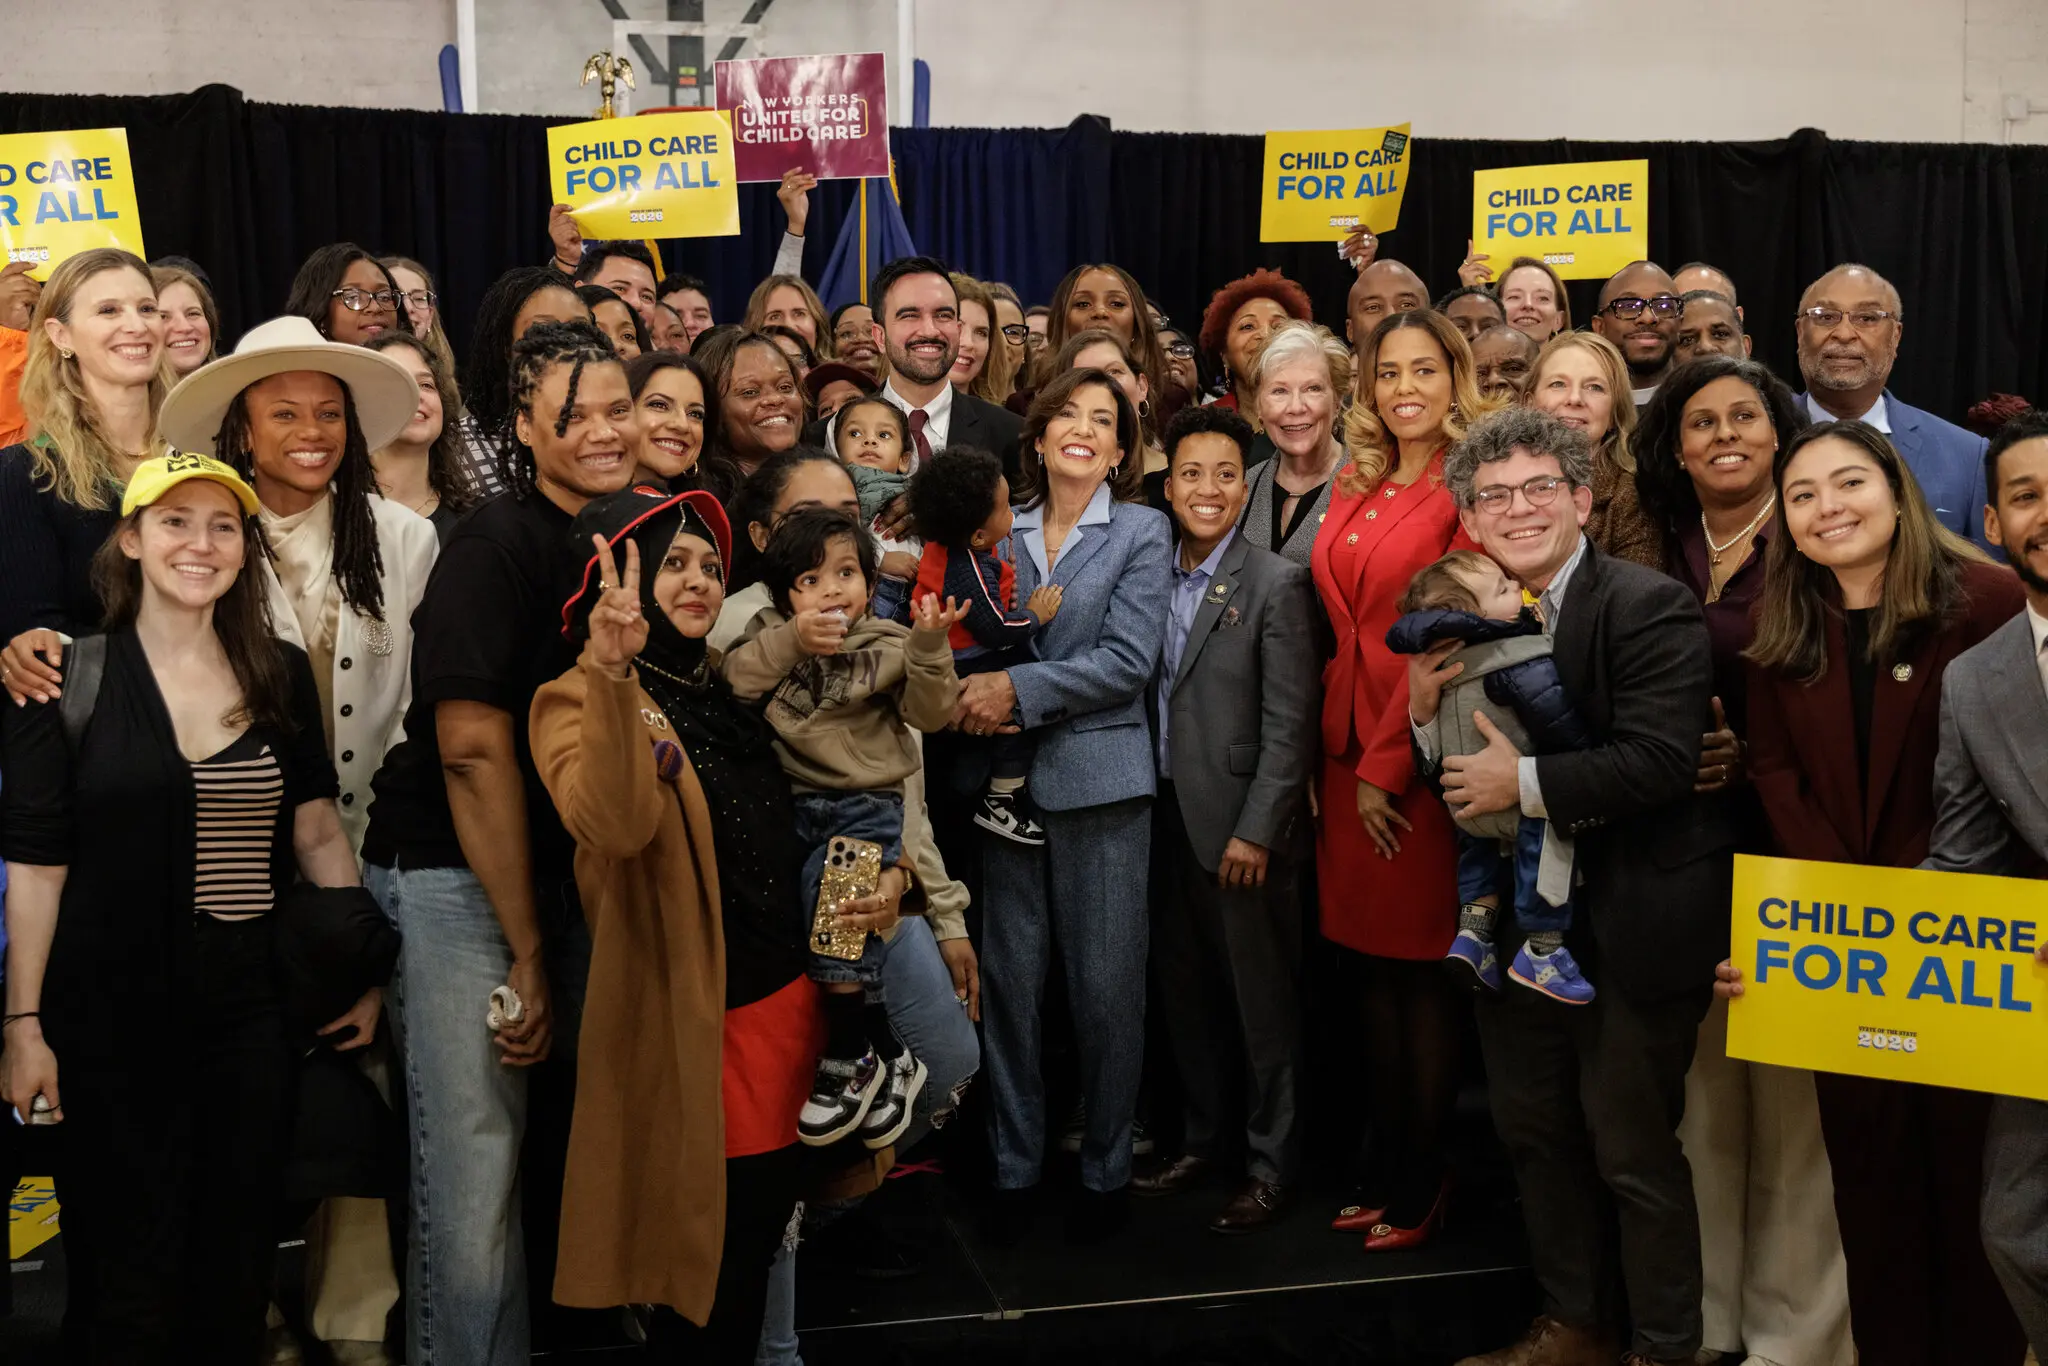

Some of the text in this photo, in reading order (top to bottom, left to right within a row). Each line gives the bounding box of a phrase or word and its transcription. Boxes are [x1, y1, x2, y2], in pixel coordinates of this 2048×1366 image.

[743, 93, 859, 109] NW YORKERS
[742, 107, 860, 127] UNITED FOR
[743, 124, 862, 144] CHILD CARE
[565, 134, 718, 164] CHILD CARE
[1280, 151, 1349, 170] CHILD
[25, 157, 113, 184] CARE
[566, 161, 721, 195] FOR ALL
[1278, 169, 1398, 200] FOR ALL
[1488, 183, 1633, 208] CHILD CARE
[35, 188, 119, 225] ALL
[630, 211, 664, 223] 2026
[1329, 217, 1360, 227] 2026
[1487, 207, 1632, 239] FOR ALL
[1543, 254, 1575, 265] 2026
[1758, 897, 2037, 954] CHILD CARE
[1755, 938, 2032, 1013] FOR ALL
[1857, 1031, 1918, 1053] 2026
